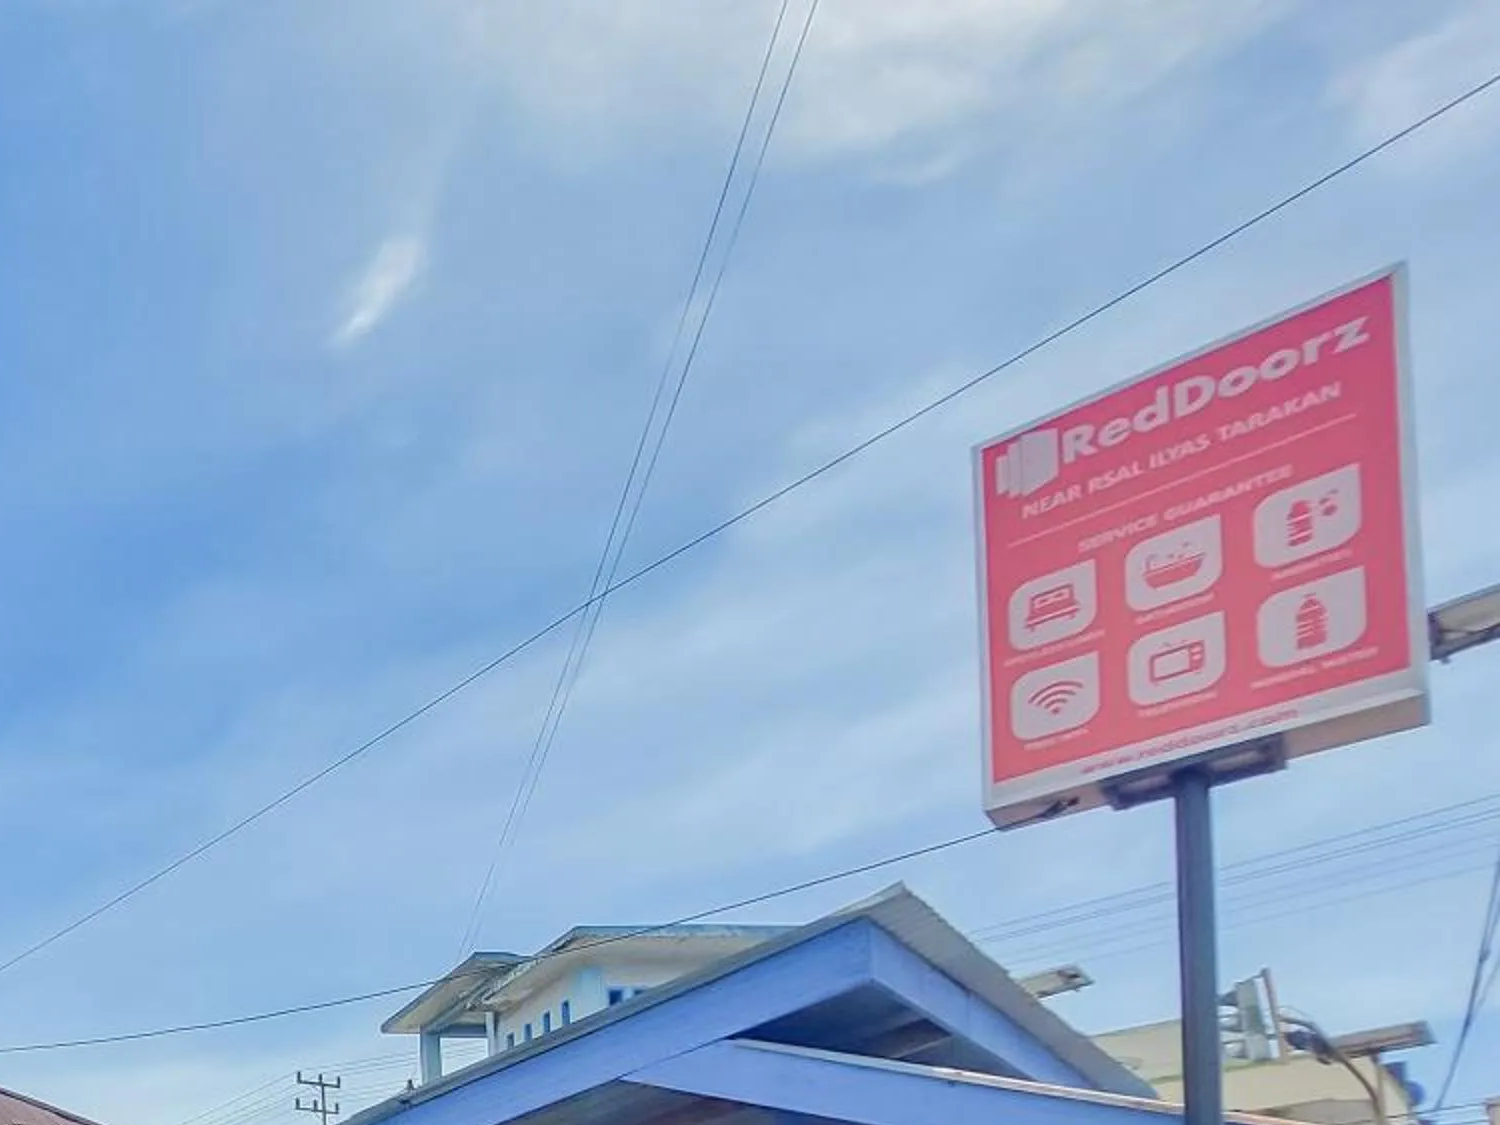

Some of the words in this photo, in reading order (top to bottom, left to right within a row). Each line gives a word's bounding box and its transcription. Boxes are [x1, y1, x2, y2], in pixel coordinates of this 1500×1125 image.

[1022, 485, 1082, 518] NEAR
[1089, 461, 1145, 494] RSAL
[1150, 433, 1211, 468] ILYAS
[1217, 382, 1341, 442] TARAKAN
[1062, 316, 1370, 464] RedDoorz
[1077, 513, 1158, 552] SERVICE
[1163, 465, 1293, 520] GUARANTEE
